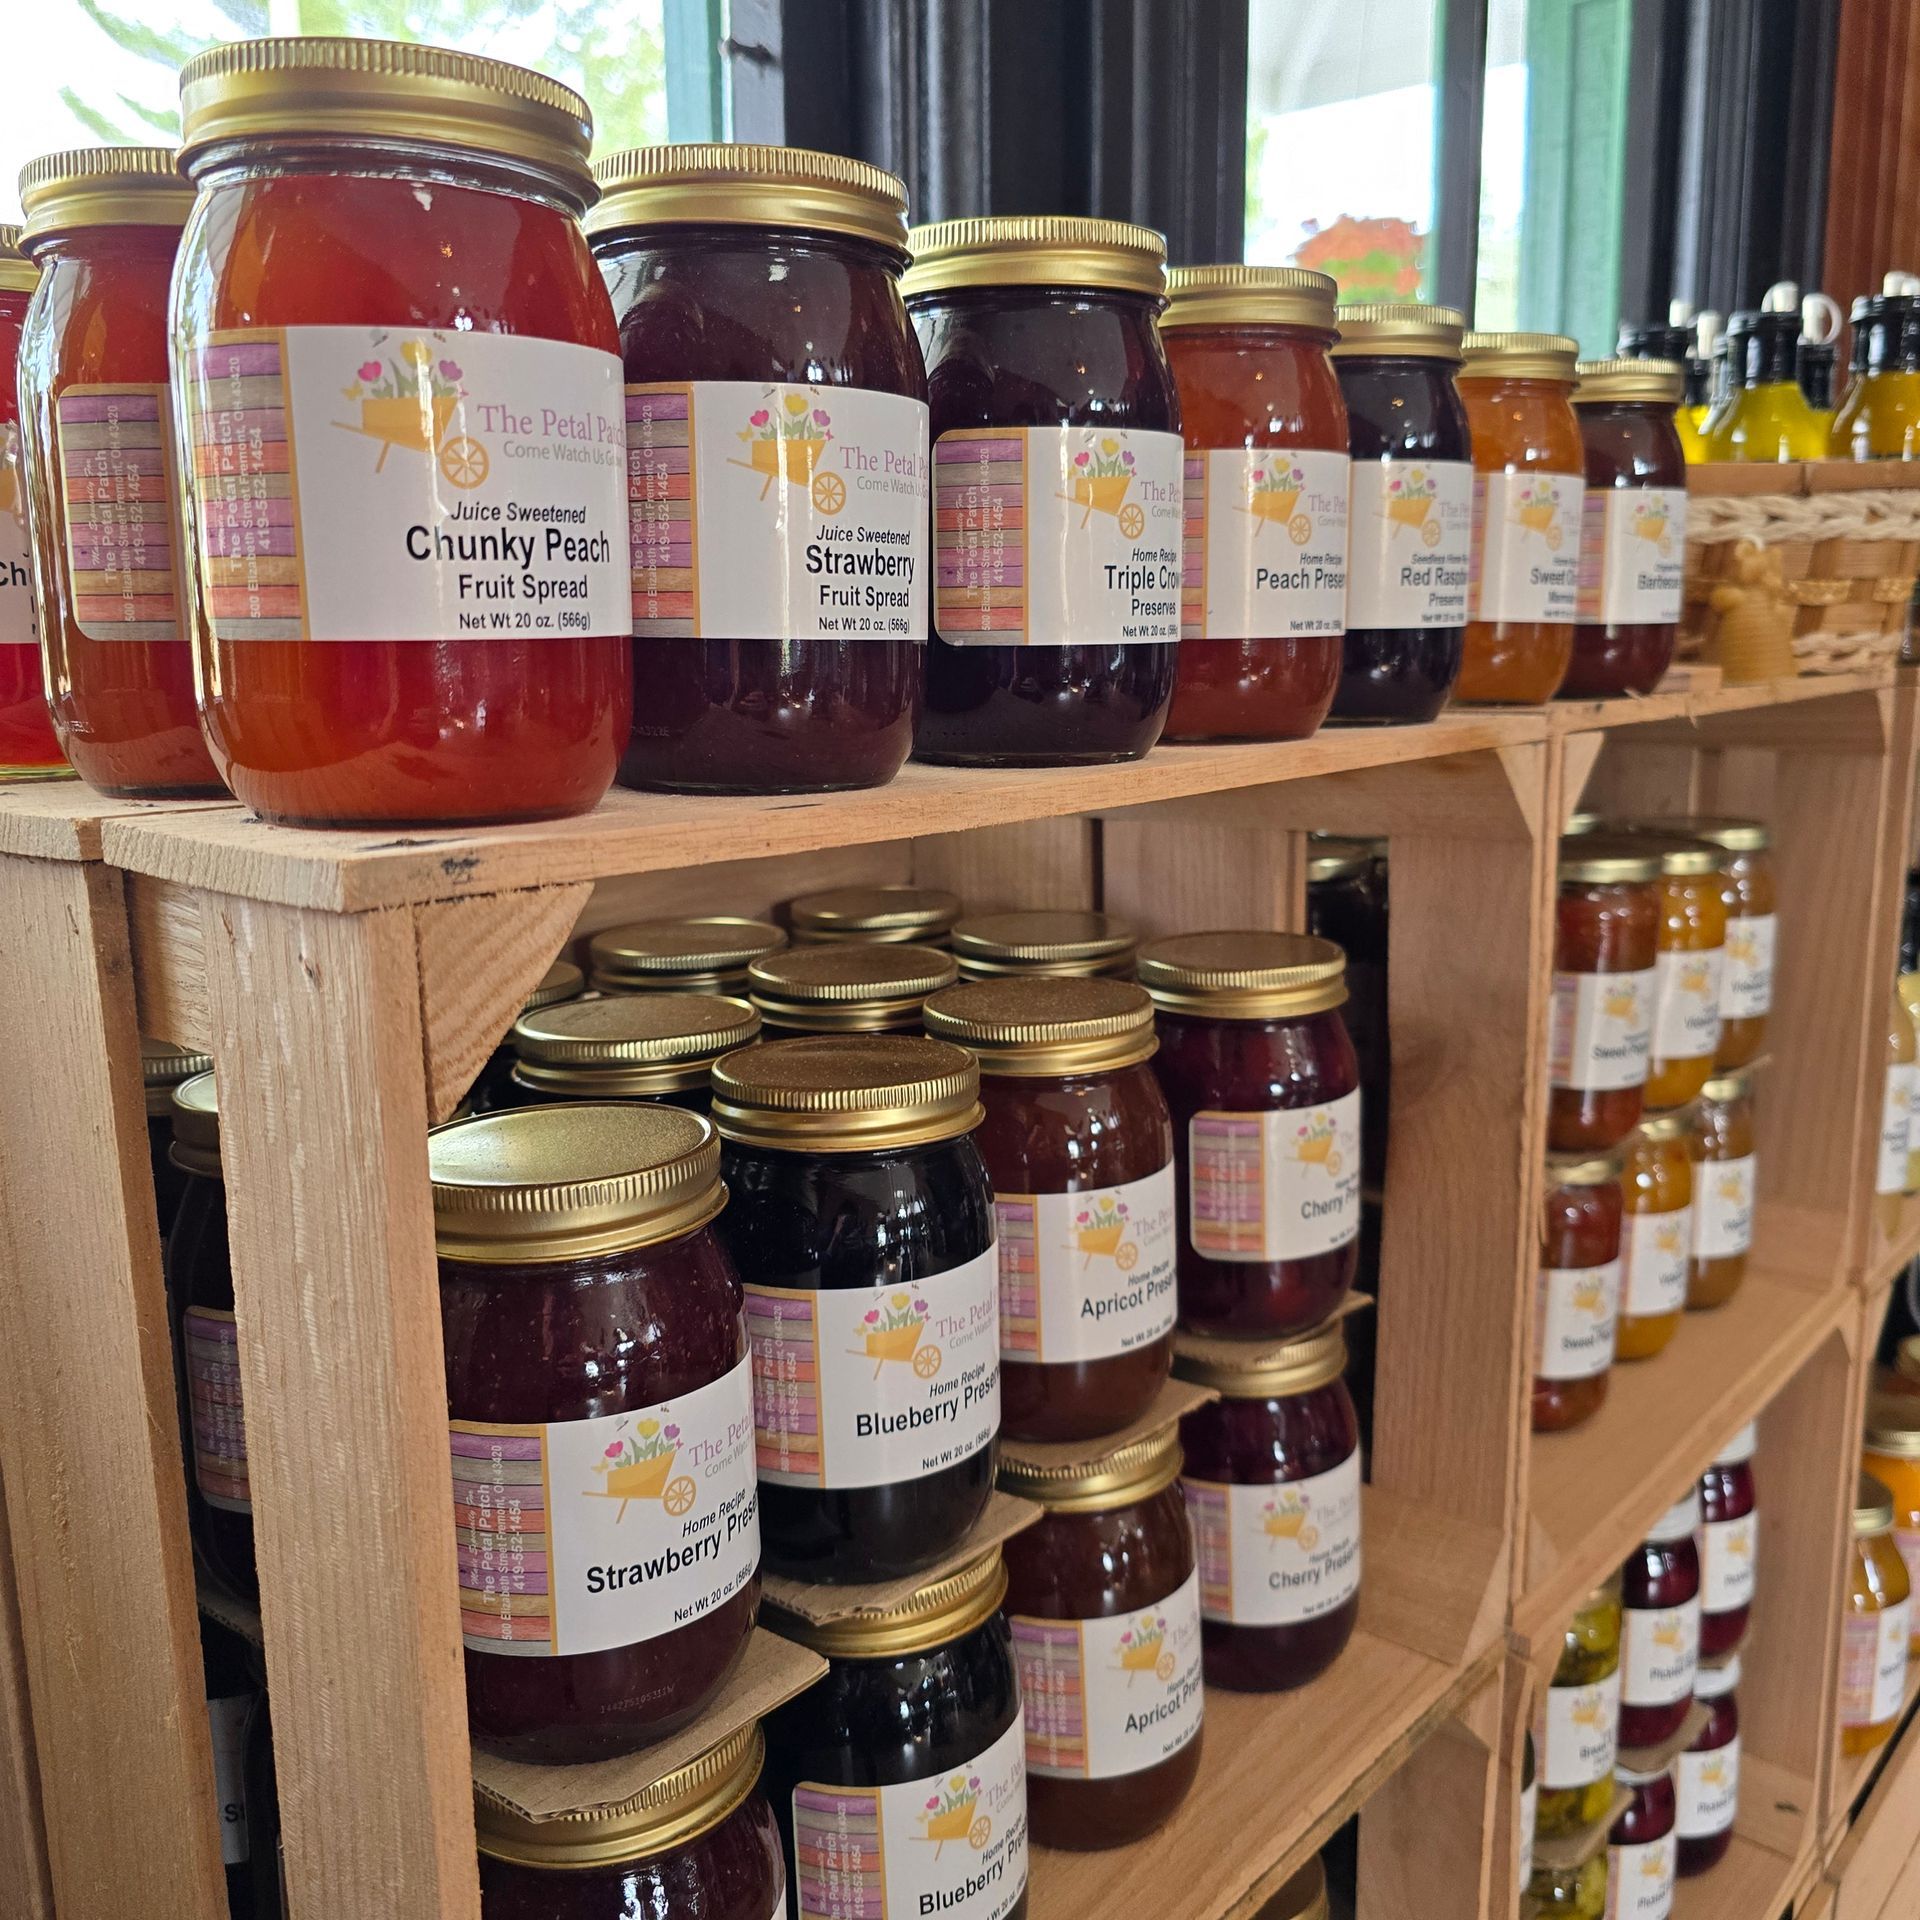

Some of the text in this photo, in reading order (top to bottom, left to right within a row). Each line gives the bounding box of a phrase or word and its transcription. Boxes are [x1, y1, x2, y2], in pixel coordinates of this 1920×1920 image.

[228, 357, 241, 397] 43420
[107, 405, 119, 438] 43420
[477, 404, 532, 434] The
[540, 408, 592, 441] Petal
[642, 405, 653, 439] 43420
[111, 438, 121, 459] OH
[504, 441, 549, 460] Come
[553, 444, 591, 463] Watch
[593, 448, 604, 464] Us
[644, 441, 653, 459] OH
[840, 446, 878, 471] The
[884, 450, 916, 476] Petal
[219, 412, 242, 572] The Petal Patch
[250, 428, 271, 549] 419-552-1454
[857, 475, 888, 492] Come
[890, 479, 915, 495] Watch
[1141, 481, 1165, 501] The
[95, 450, 117, 583] The Petal Patch
[127, 463, 146, 566] 419-552-1454
[240, 487, 252, 528] Street
[451, 501, 586, 524] Juice Sweetened
[629, 450, 644, 579] The Petal Patch
[657, 462, 670, 563] 419-552-1454
[1152, 505, 1170, 518] Come
[1308, 494, 1331, 512] The
[116, 513, 129, 547] Street
[645, 511, 656, 545] Street
[817, 525, 910, 545] Juice Sweetened
[965, 486, 978, 599] The Petal Patch
[993, 498, 1004, 583] 419-552-1454
[245, 530, 259, 591] Elizabeth
[406, 525, 610, 570] Chunky Peach
[981, 540, 991, 568] Street
[1132, 548, 1157, 562] Home
[1300, 553, 1323, 565] Home
[120, 549, 133, 600] Elizabeth
[647, 547, 658, 597] Elizabeth
[806, 545, 915, 585] Strawberry
[1104, 565, 1155, 595] Triple
[1256, 568, 1309, 589] Peach
[1401, 567, 1431, 586] Red
[458, 574, 588, 604] Fruit Spread
[820, 585, 909, 611] Fruit Spread
[980, 570, 991, 613] Elizabeth
[124, 602, 135, 622] 500
[250, 595, 261, 618] 500
[459, 612, 591, 631] Net Wt 20 oz. (566g)
[648, 601, 658, 619] 500
[1131, 599, 1176, 616] Preserves
[819, 617, 910, 634] Net Wt 20 oz. (566g)
[981, 615, 991, 631] 500
[1123, 626, 1137, 637] Net
[1138, 626, 1149, 637] Wt
[1150, 625, 1158, 636] 20
[1290, 620, 1303, 631] Net
[1305, 620, 1315, 631] Wt
[1301, 1194, 1343, 1219] Cherry
[936, 1290, 993, 1338] The Petal
[1081, 1289, 1143, 1321] Apricot
[763, 1338, 774, 1376] Patch
[211, 1362, 222, 1400] Patch
[786, 1352, 800, 1430] 419-552-1454
[930, 1363, 986, 1398] Home Recipe
[856, 1396, 959, 1437] Blueberry
[490, 1445, 503, 1477] 43420
[689, 1435, 723, 1468] The
[705, 1455, 733, 1478] Come
[922, 1457, 939, 1470] Net
[940, 1450, 952, 1464] Wt
[954, 1446, 964, 1459] 20
[493, 1478, 505, 1494] OH
[682, 1488, 746, 1538] Home Recipe
[477, 1484, 497, 1604] The Petal Patch
[497, 1542, 509, 1573] Street
[509, 1499, 525, 1591] 419-552-1454
[587, 1530, 722, 1594] Strawberry
[674, 1559, 753, 1623] Net Wt 20 oz. (566g)
[1269, 1567, 1321, 1590] Cherry
[499, 1575, 512, 1621] Elizabeth
[501, 1623, 513, 1640] 500
[1125, 1694, 1181, 1734] Apricot
[982, 1839, 1004, 1865] Home
[919, 1853, 1004, 1915] Blueberry
